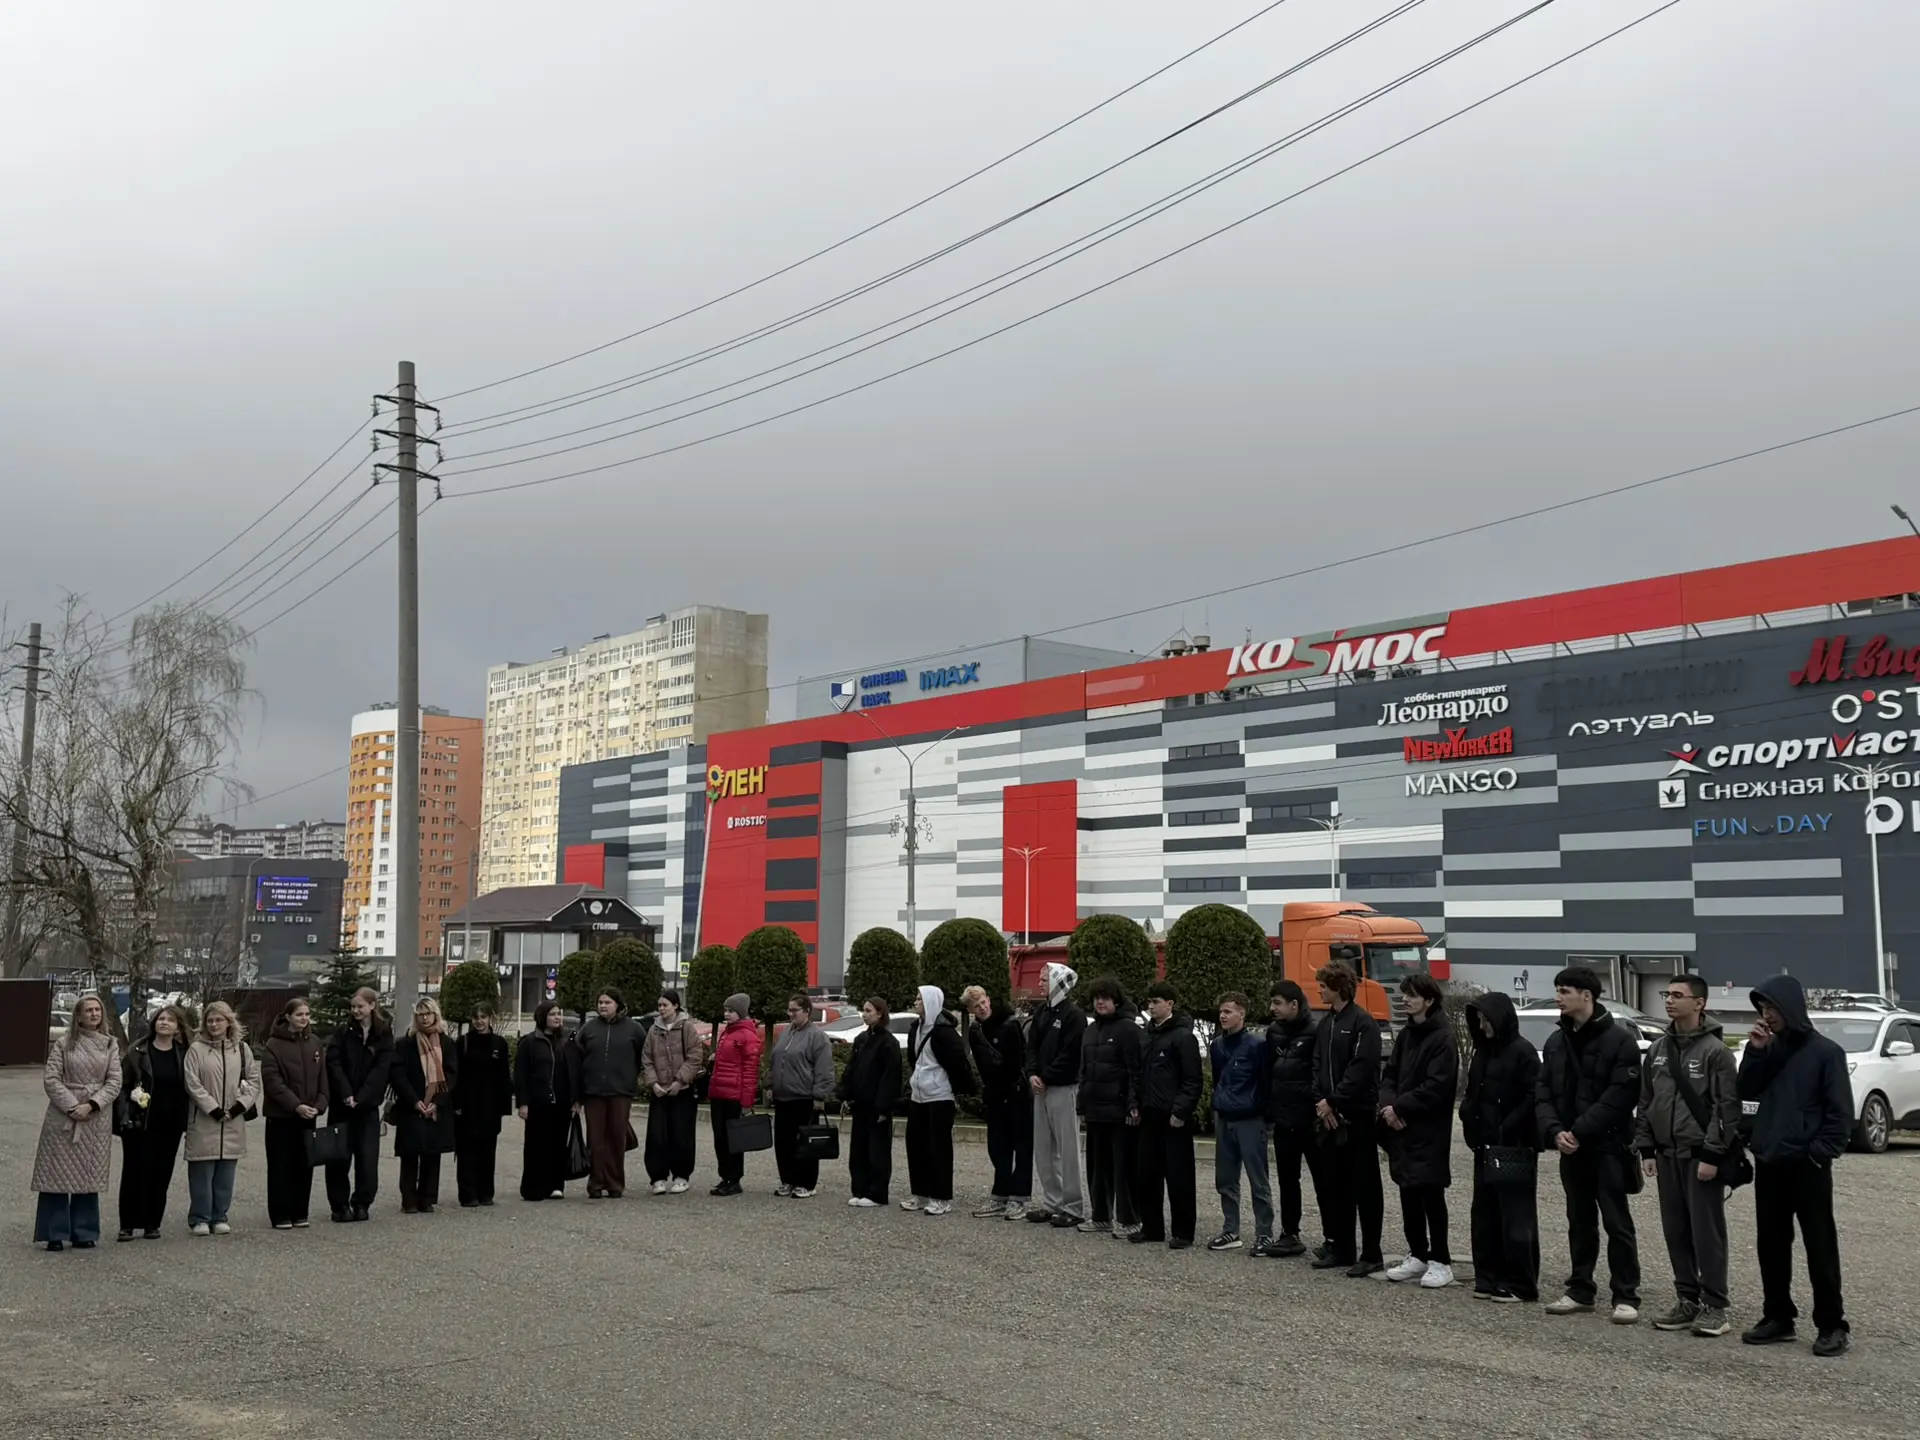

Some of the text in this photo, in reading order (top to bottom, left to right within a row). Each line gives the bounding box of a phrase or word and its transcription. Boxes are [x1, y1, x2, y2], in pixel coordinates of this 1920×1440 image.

[860, 669, 907, 689] СИНЕМА
[919, 662, 980, 691] IMAX
[861, 691, 891, 707] ПАРК
[1404, 684, 1507, 704] хобби-гипермаркет
[1377, 695, 1509, 726] Леонардо
[721, 765, 769, 798] ЛЕН
[1405, 767, 1518, 797] MANGO
[1699, 777, 1824, 800] Снежная
[1694, 813, 1833, 837] FUN DAY
